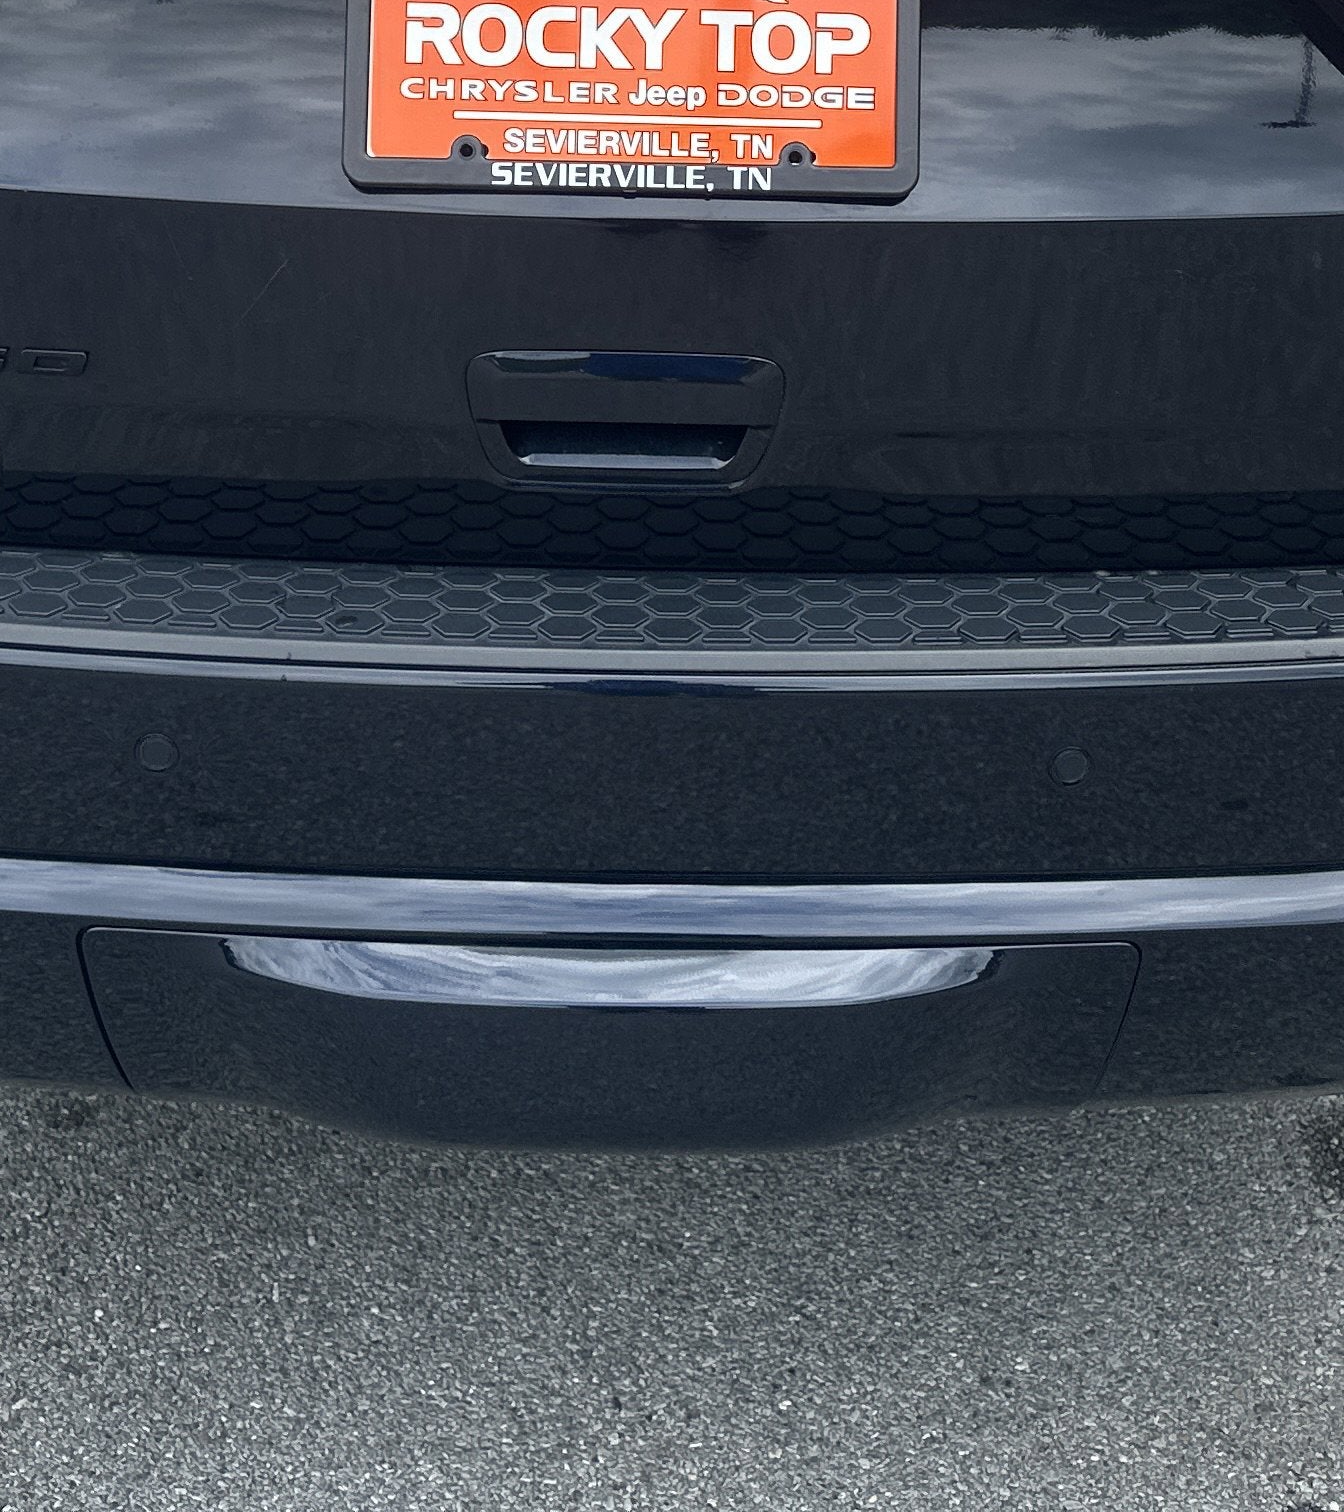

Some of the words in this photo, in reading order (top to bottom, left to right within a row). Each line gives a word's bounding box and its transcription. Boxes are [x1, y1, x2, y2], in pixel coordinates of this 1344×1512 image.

[404, 1, 687, 72] ROCKY
[701, 9, 871, 75] TOP
[400, 77, 618, 105] CHRYSLER
[628, 78, 707, 109] Jeep
[717, 82, 876, 110] DODGE
[502, 127, 721, 163] SEVIERVILLE,
[730, 134, 773, 159] TN
[491, 162, 715, 192] SEVIERVILLE,
[726, 166, 772, 191] TN
